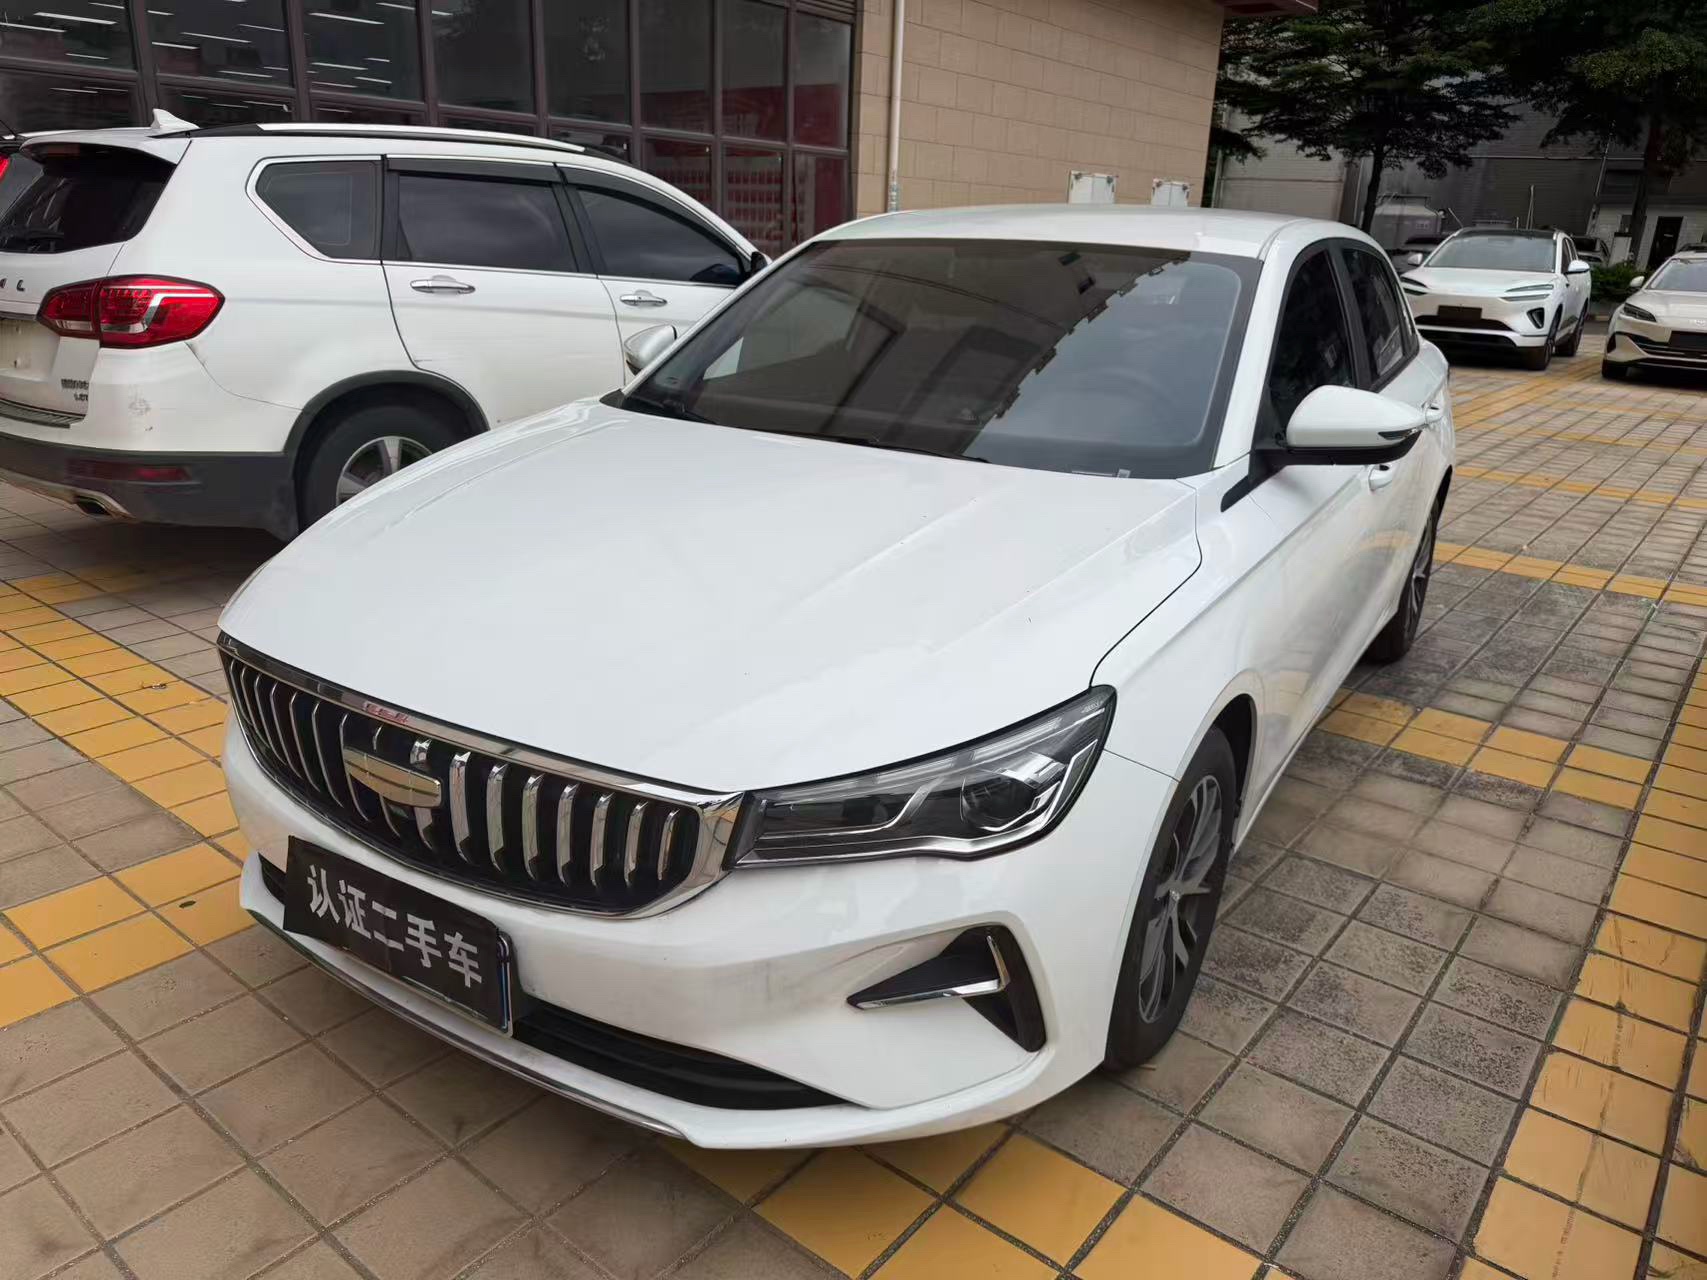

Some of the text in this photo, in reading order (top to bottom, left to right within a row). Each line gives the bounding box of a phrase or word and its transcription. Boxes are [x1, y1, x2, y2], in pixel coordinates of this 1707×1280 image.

[307, 864, 482, 988] 认证二手车
